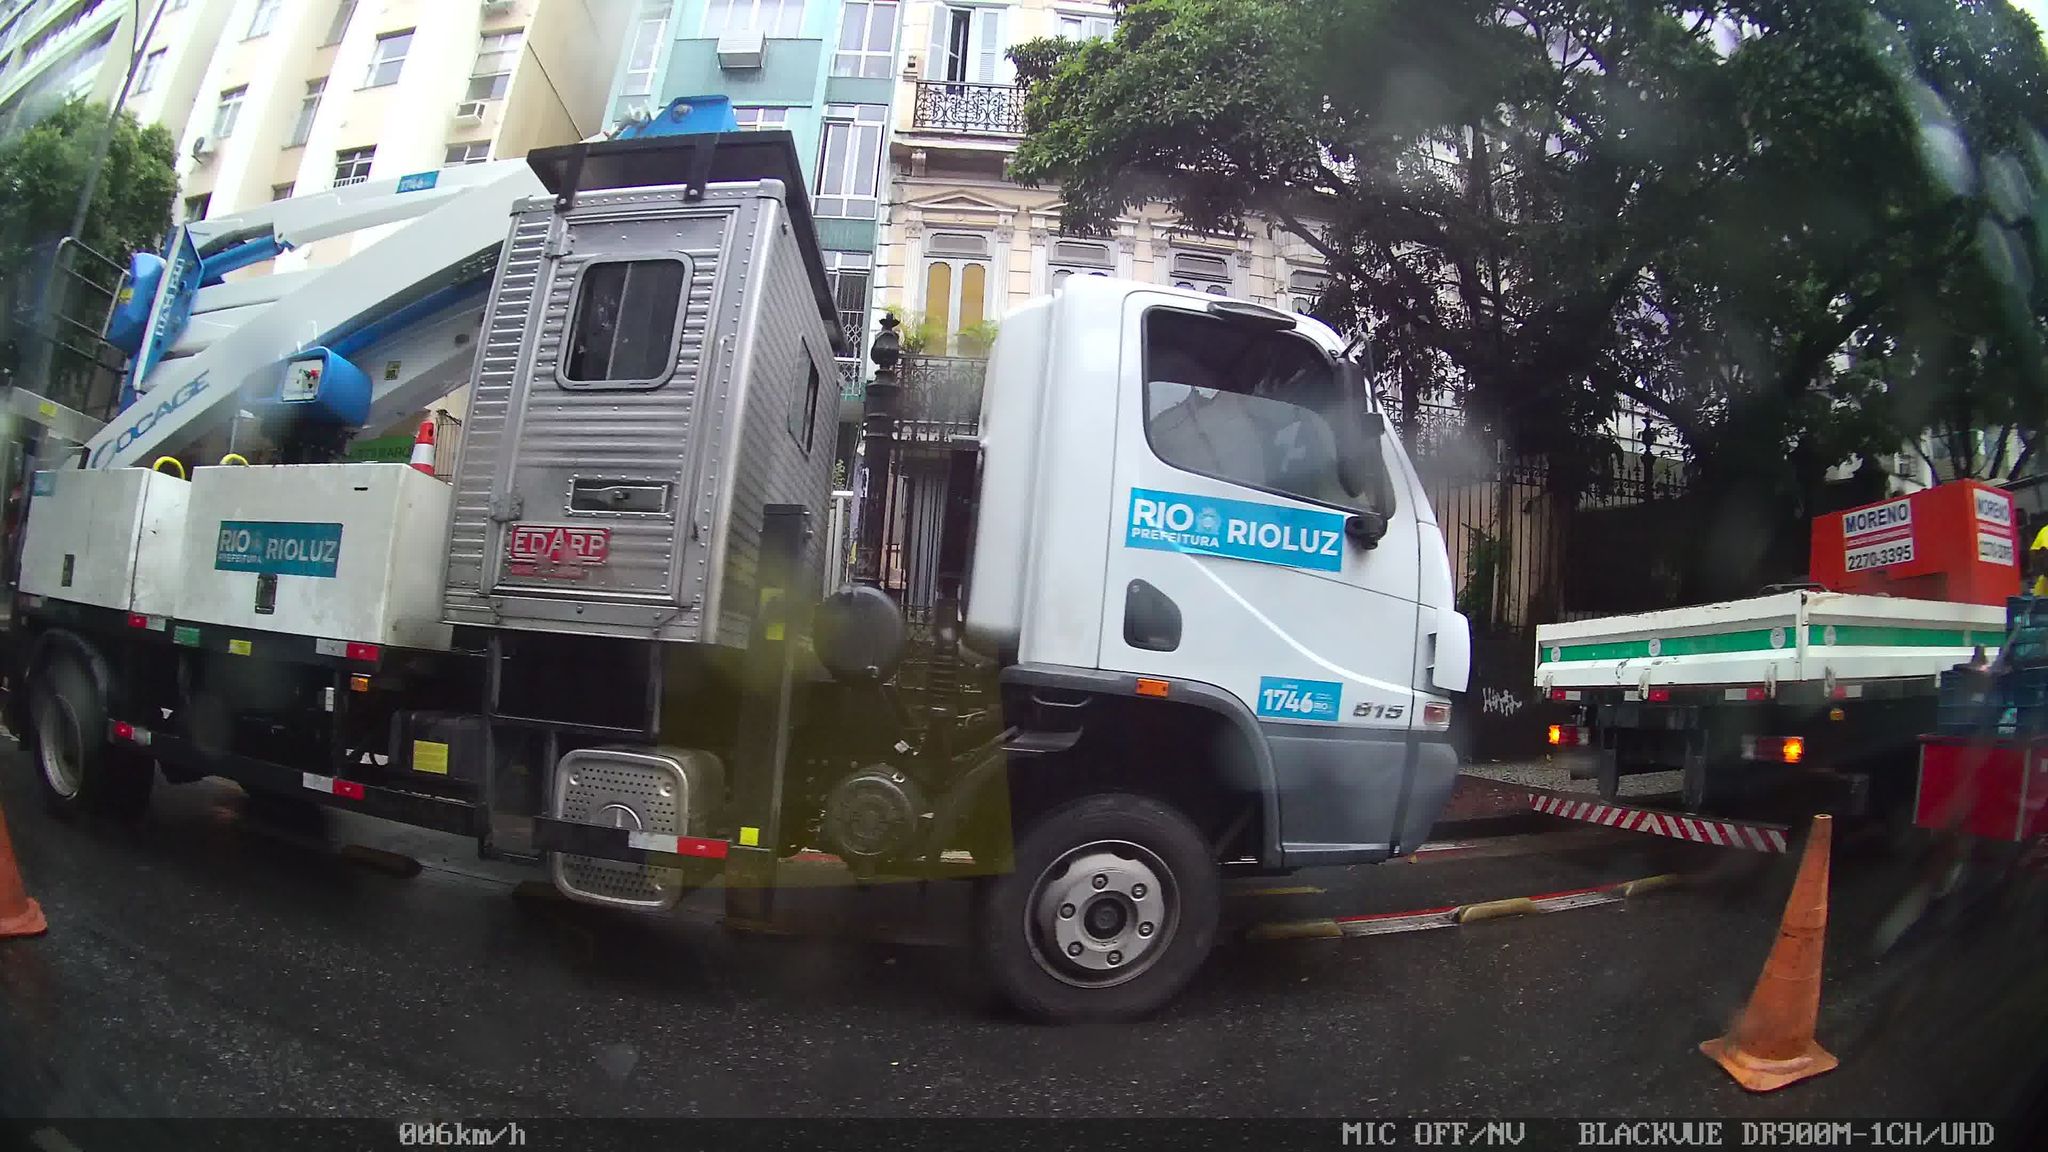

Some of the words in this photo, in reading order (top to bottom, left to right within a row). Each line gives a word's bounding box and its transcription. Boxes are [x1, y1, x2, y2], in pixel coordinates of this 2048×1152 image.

[1132, 498, 1194, 531] RIO
[1845, 503, 1908, 534] MORENO
[218, 529, 250, 552] RIO
[265, 537, 338, 563] RIOLUZ
[513, 527, 606, 557] EDARP
[1131, 527, 1220, 548] PREFEITURA
[1227, 518, 1339, 556] RIOLUZ
[1847, 544, 1912, 571] 2270-3395
[1263, 688, 1314, 714] 1746
[1352, 701, 1406, 719] 815
